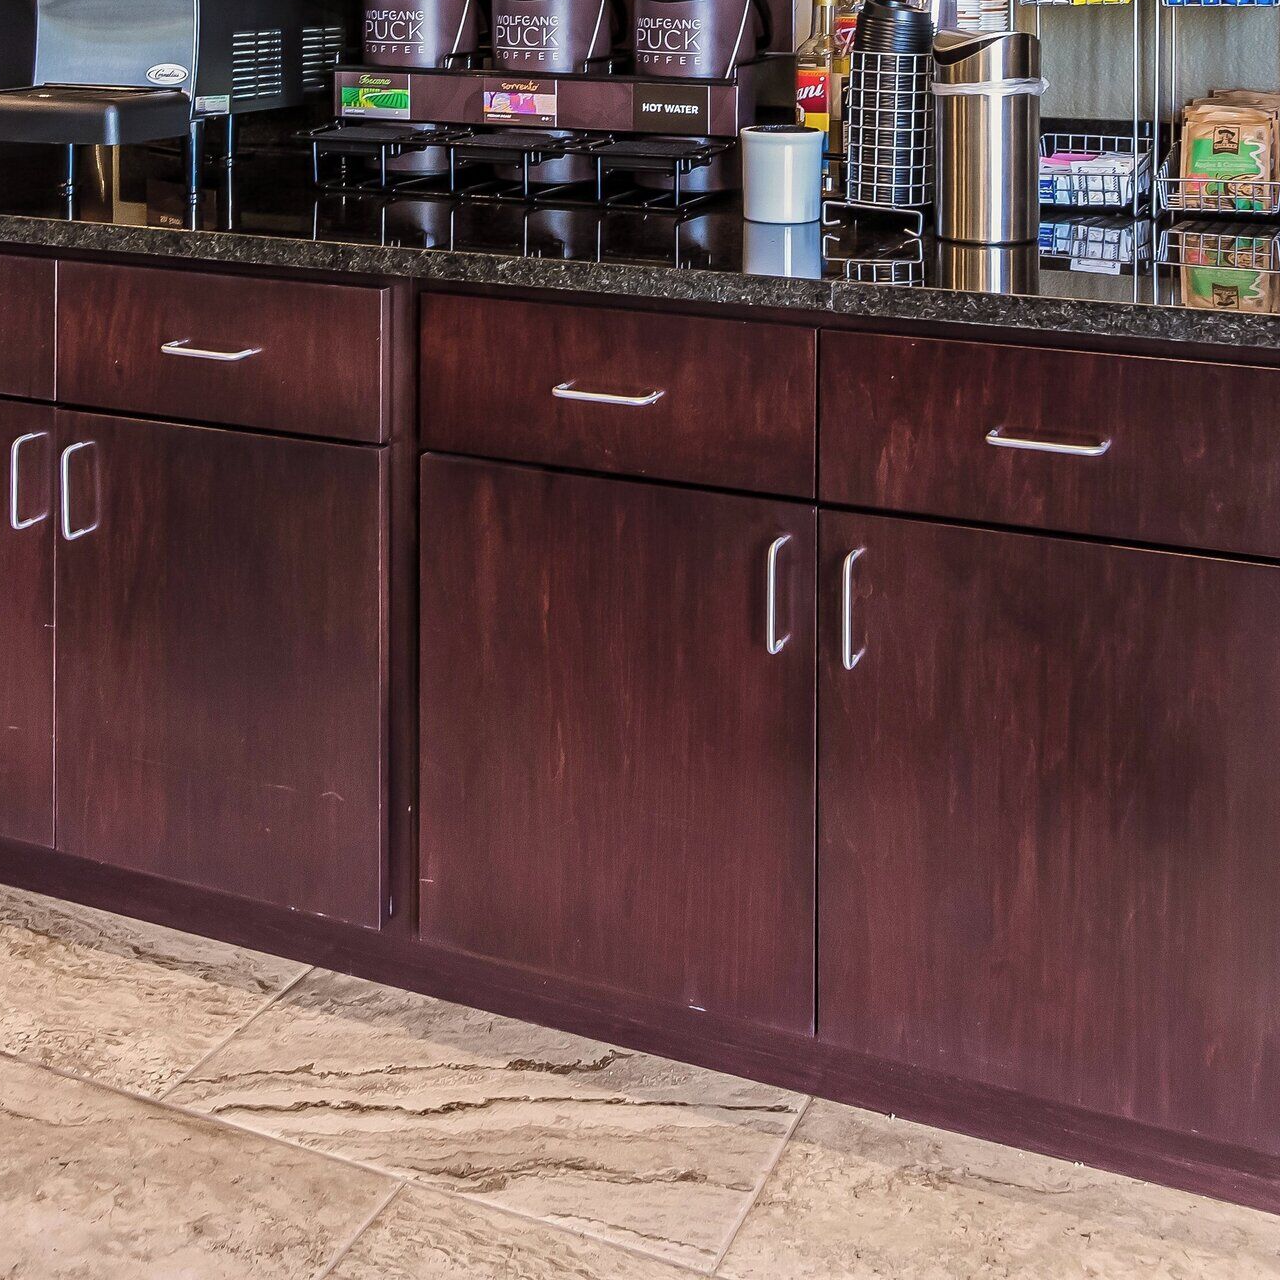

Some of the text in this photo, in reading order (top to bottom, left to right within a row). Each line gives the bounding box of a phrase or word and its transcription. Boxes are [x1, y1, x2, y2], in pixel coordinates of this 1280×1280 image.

[365, 10, 424, 21] WOLFGANG
[496, 15, 559, 26] WOLFGANG
[636, 17, 701, 30] WOLFGANG
[365, 20, 424, 40] PUCK
[496, 25, 559, 46] PUCK
[636, 28, 701, 50] PUCK
[365, 44, 424, 54] COFFEE
[496, 50, 559, 61] COFFEE
[636, 54, 701, 65] COFFEE
[642, 102, 699, 115] HOT WATER
